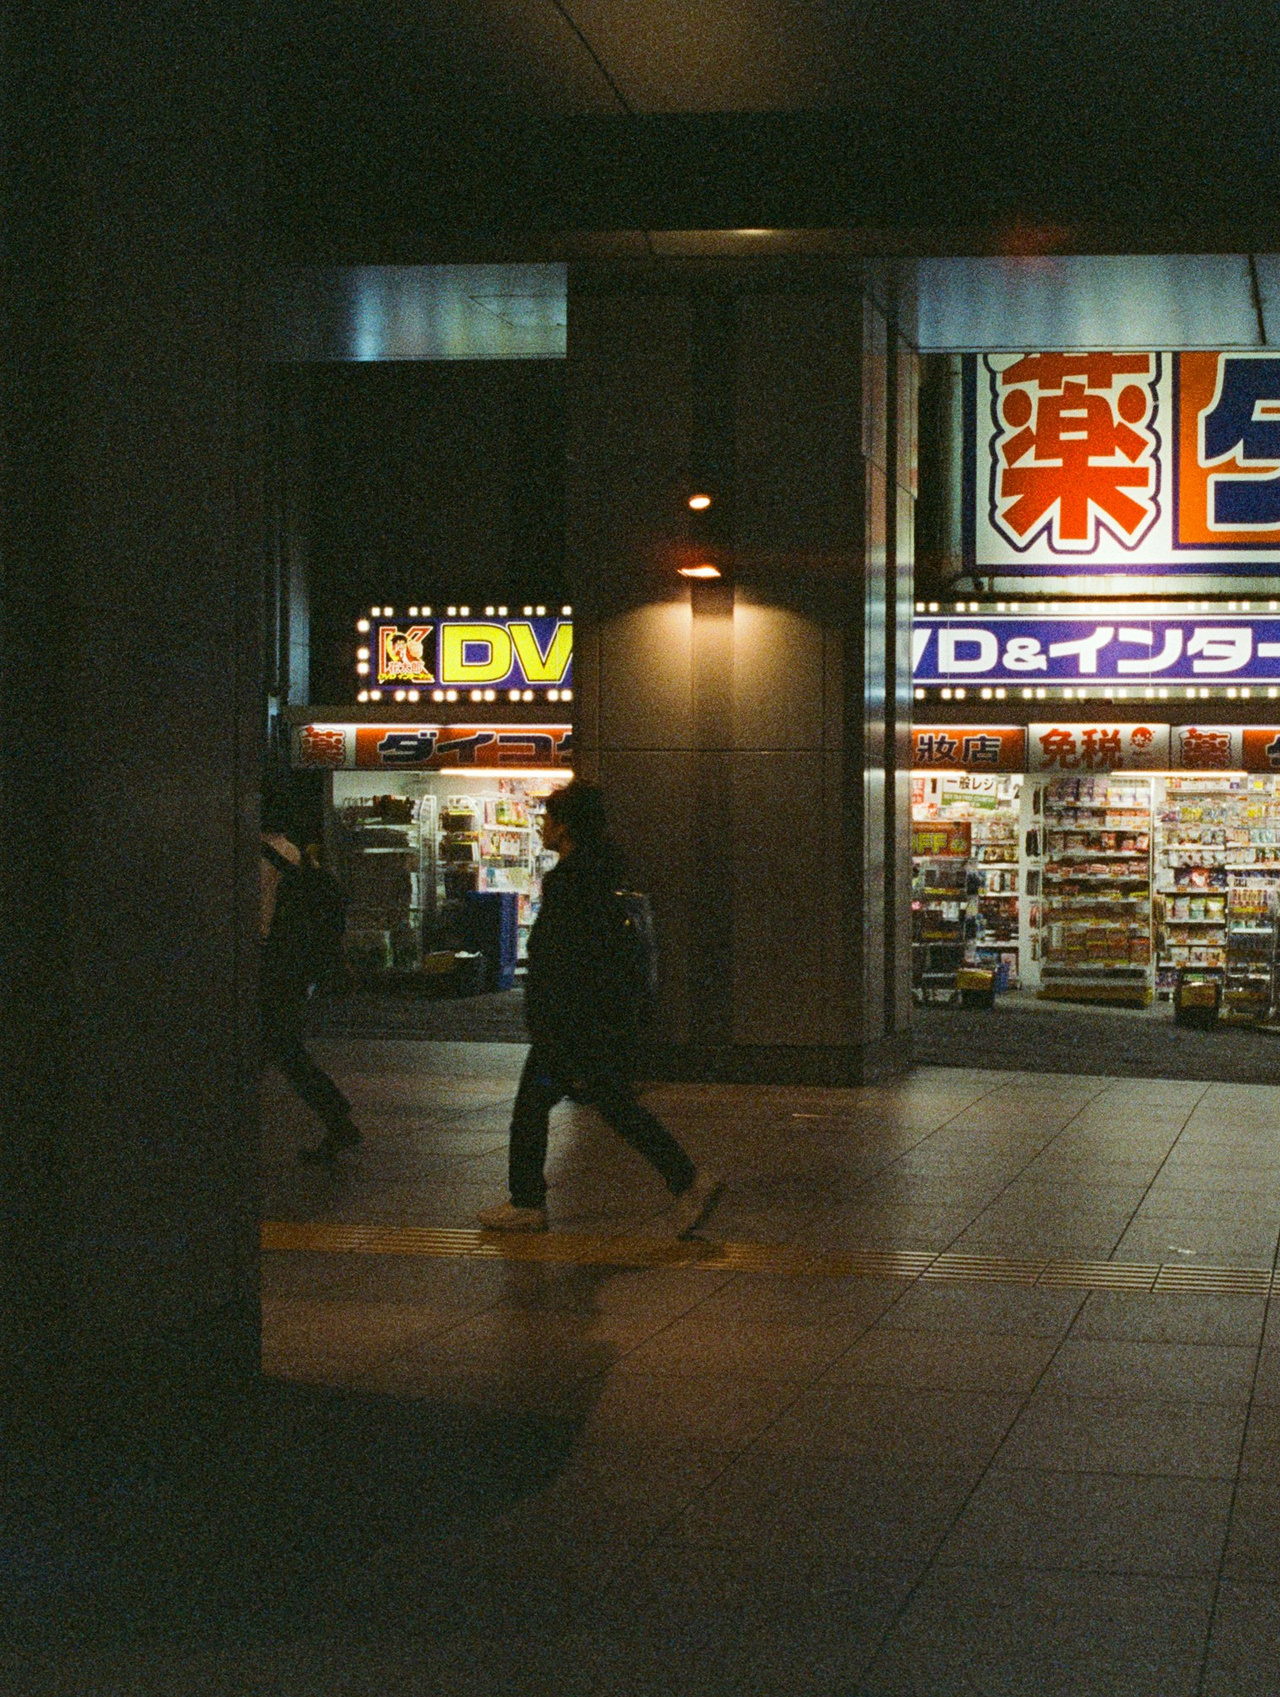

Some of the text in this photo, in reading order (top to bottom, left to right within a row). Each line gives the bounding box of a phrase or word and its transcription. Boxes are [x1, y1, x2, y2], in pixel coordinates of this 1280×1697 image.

[1000, 352, 1150, 541] 薬
[441, 621, 573, 685] DV
[300, 726, 572, 766] 薬 ダイコ
[1038, 728, 1122, 770] 免税
[1180, 729, 1233, 768] 薬
